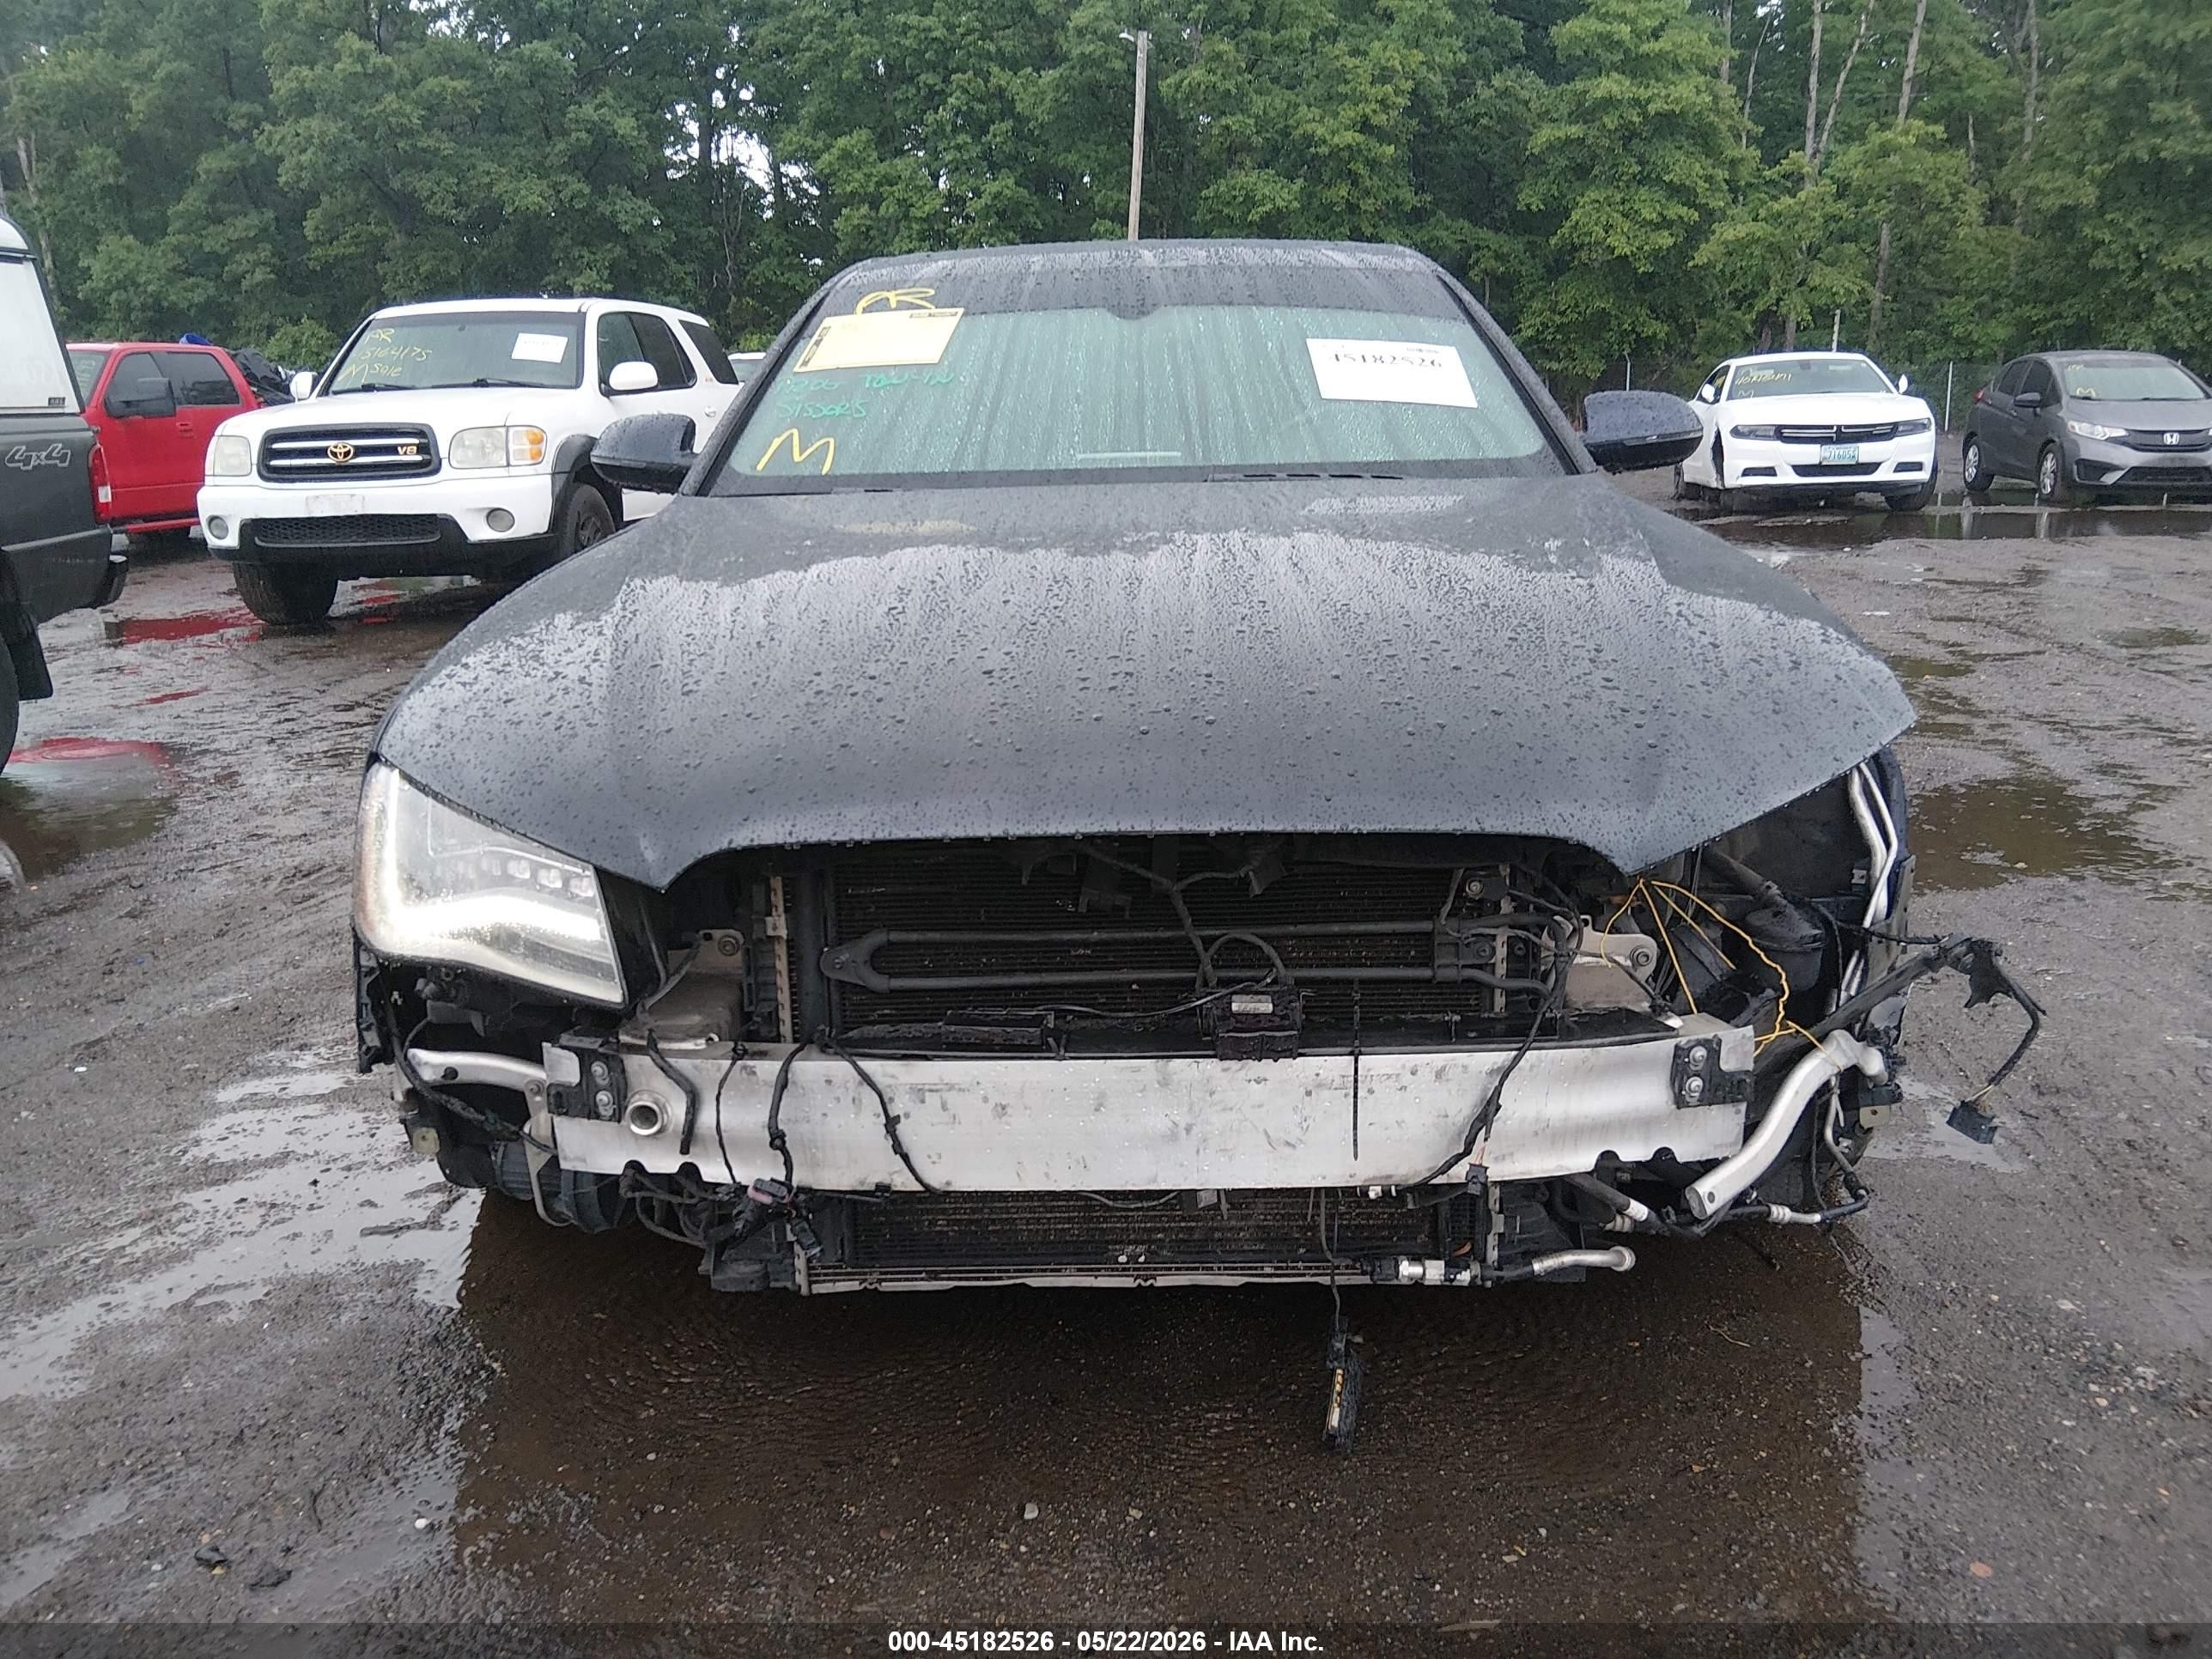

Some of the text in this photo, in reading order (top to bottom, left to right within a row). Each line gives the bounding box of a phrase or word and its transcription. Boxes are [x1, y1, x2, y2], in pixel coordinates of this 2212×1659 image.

[4, 442, 71, 471] 4x4
[397, 446, 417, 455] V8
[756, 428, 836, 477] M
